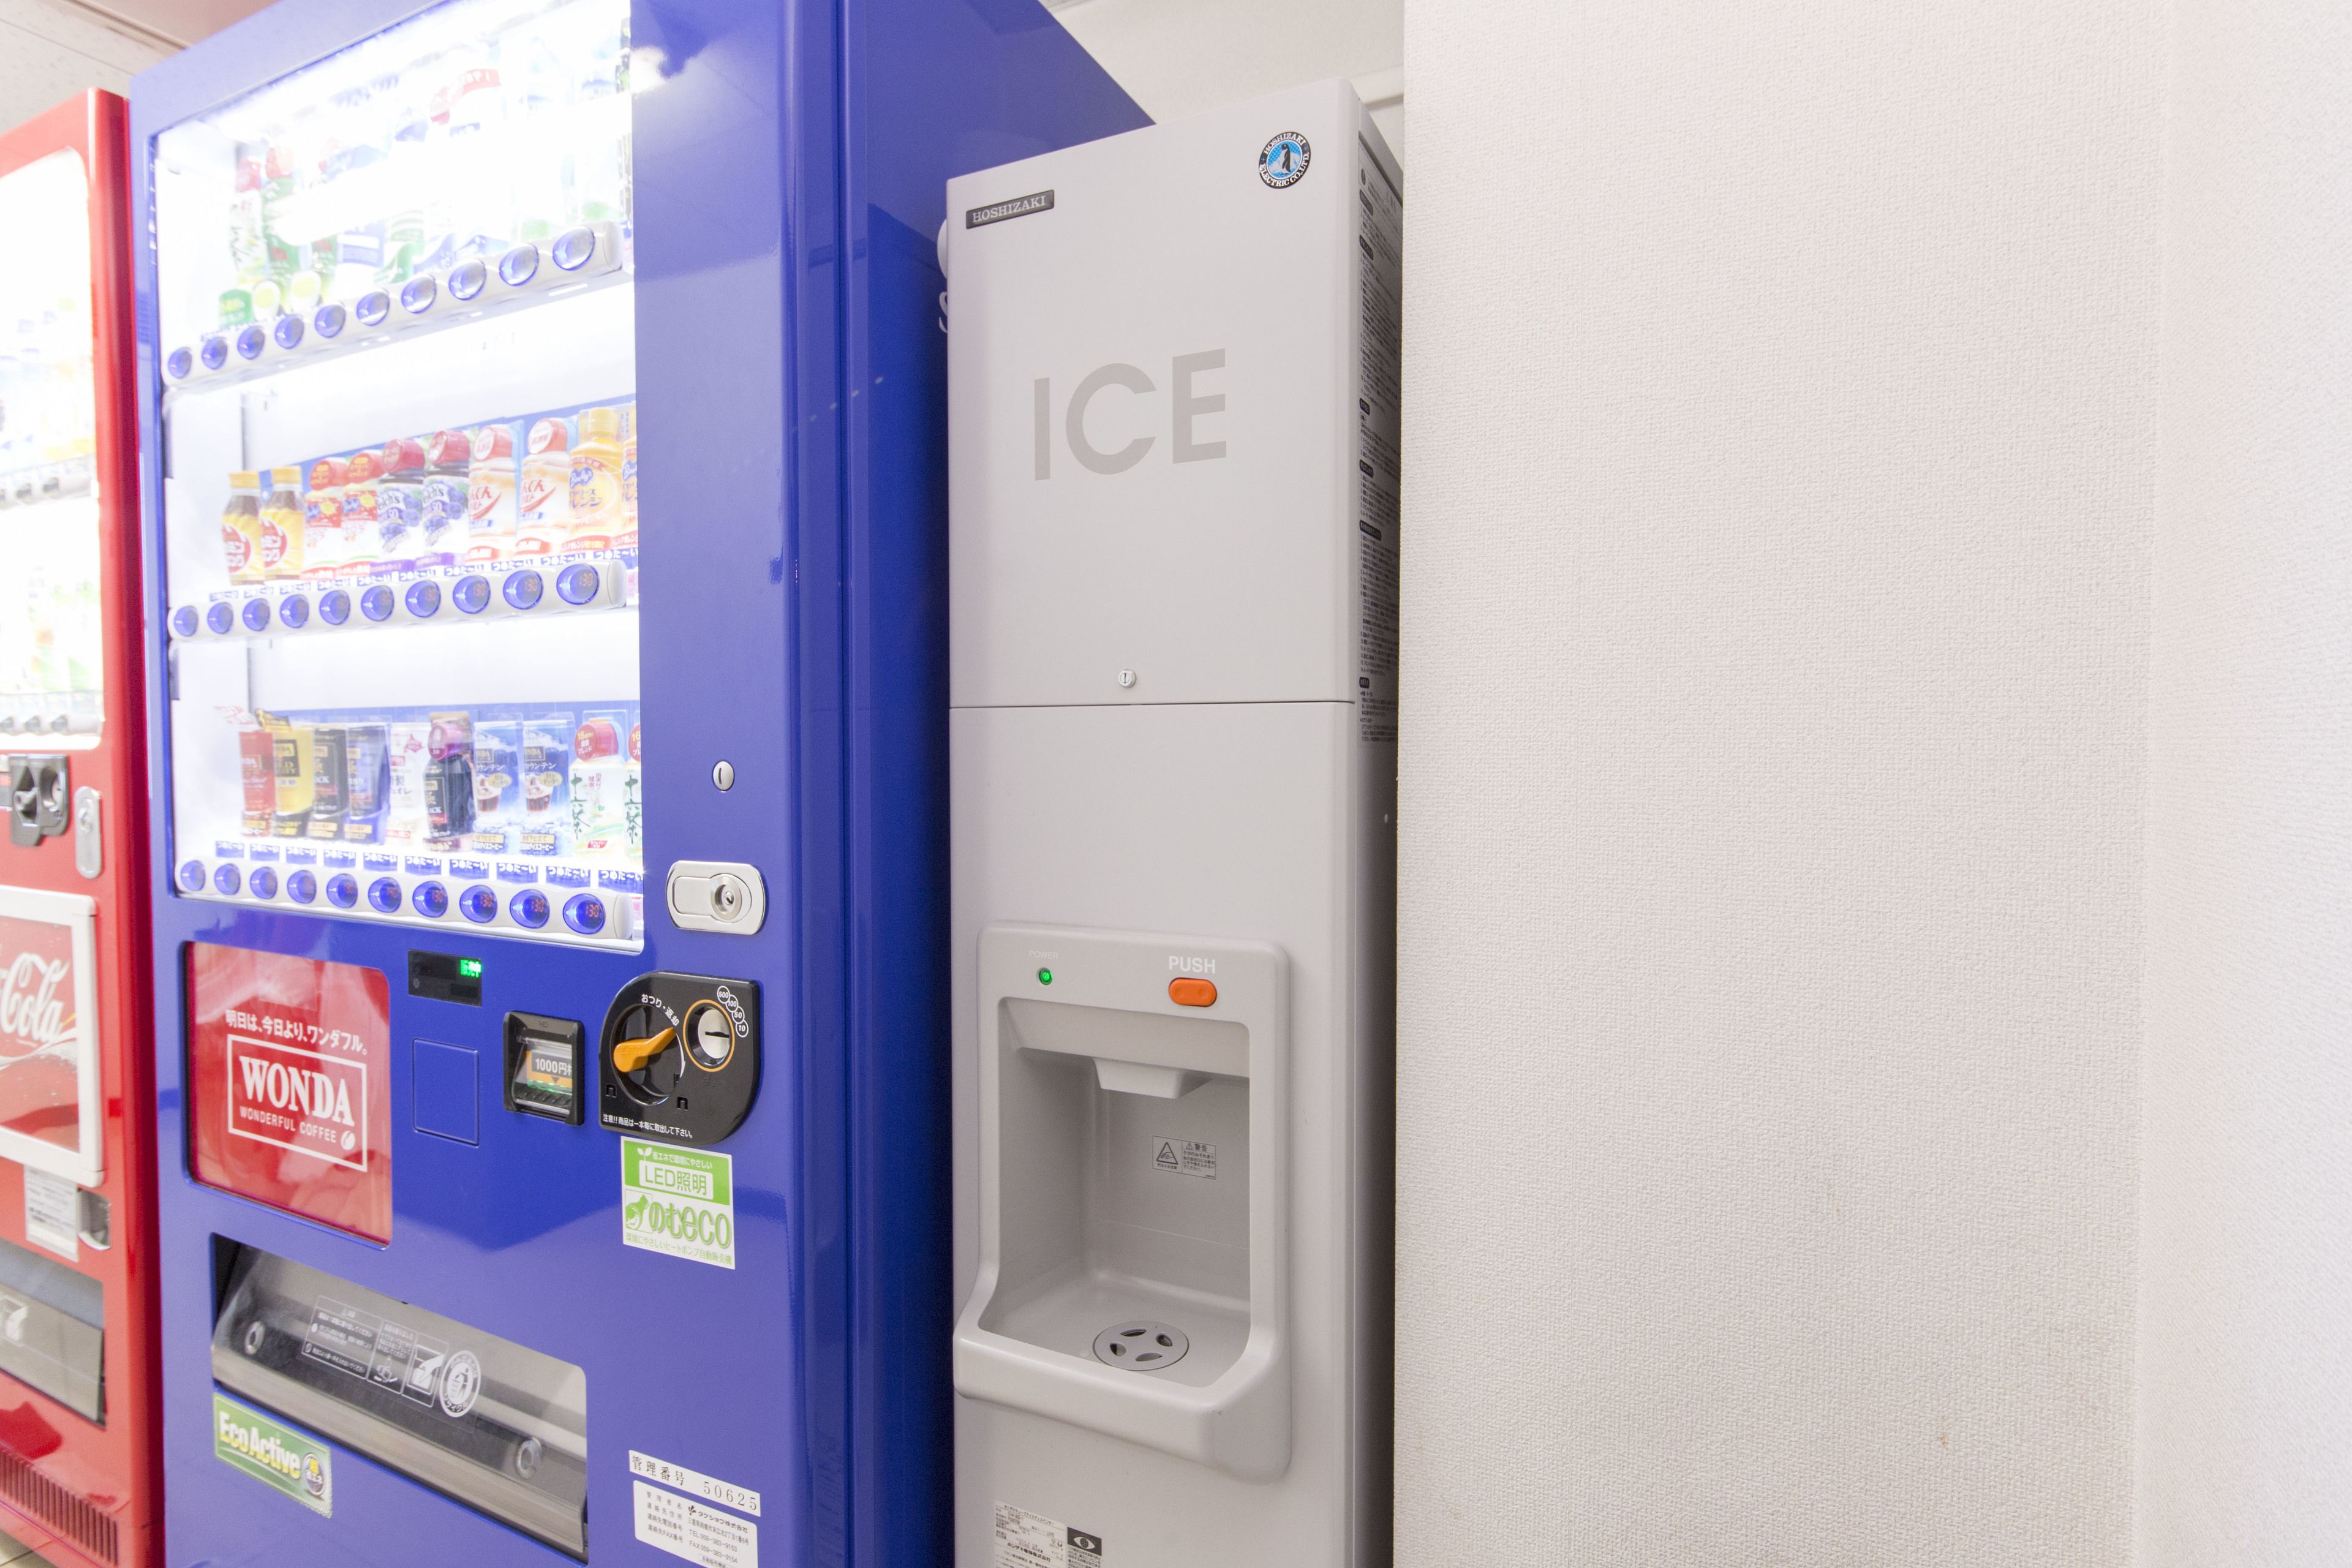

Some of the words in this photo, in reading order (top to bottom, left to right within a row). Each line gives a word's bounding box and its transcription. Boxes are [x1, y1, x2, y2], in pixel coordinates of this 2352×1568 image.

[1264, 133, 1306, 154] HOSHIZAKI
[1259, 164, 1289, 187] ELECTRIC
[973, 195, 1046, 224] HOSHIZAKI
[1034, 348, 1227, 481] ICE
[542, 554, 584, 565] つめた〜い
[595, 548, 639, 560] つめた〜い
[452, 859, 488, 870] つめた〜い
[499, 863, 537, 874] つめた〜い
[548, 867, 590, 878] つめた〜い
[601, 870, 643, 882] つめた〜い
[1028, 950, 1058, 960] POWER
[1168, 956, 1216, 974] PUSH
[718, 990, 729, 999] 500
[728, 999, 737, 1008] 100
[641, 993, 680, 1027] おつり・返却
[734, 1011, 742, 1019] 50
[225, 1009, 367, 1055] 明日は、今日より、ワンダフル。
[239, 1055, 355, 1127] WONDA
[239, 1106, 296, 1132] WONDERFUL
[300, 1121, 336, 1143] COFFEE
[652, 1151, 713, 1169] 省エネで環境にやさしい
[645, 1165, 707, 1196] LED照明
[633, 1455, 685, 1486] 管理番号
[704, 1480, 757, 1511] 50625
